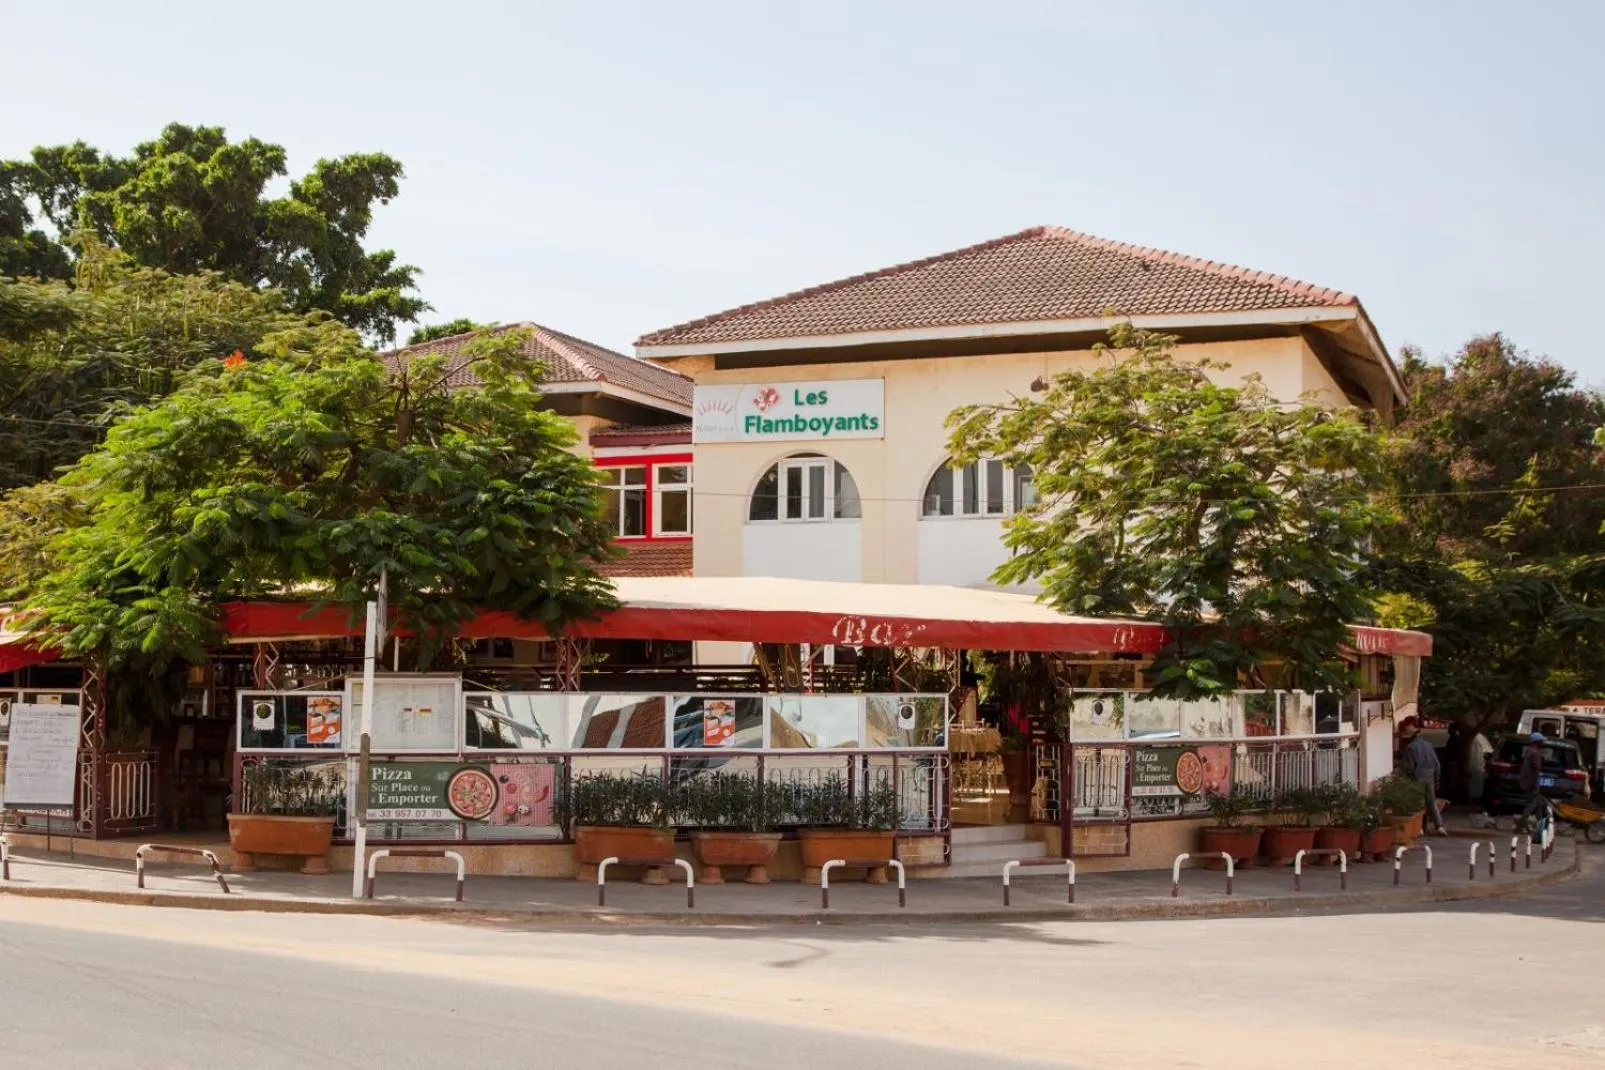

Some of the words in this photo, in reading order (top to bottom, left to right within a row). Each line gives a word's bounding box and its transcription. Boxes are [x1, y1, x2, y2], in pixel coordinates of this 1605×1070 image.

[794, 389, 829, 406] Les
[744, 412, 879, 436] Flamboyants
[1135, 750, 1158, 762] Pizza
[372, 767, 413, 780] Pizza
[371, 782, 389, 792] Sur
[391, 782, 419, 792] Place
[378, 792, 439, 806] Emporter
[380, 809, 391, 818] 33
[395, 809, 412, 818] 957
